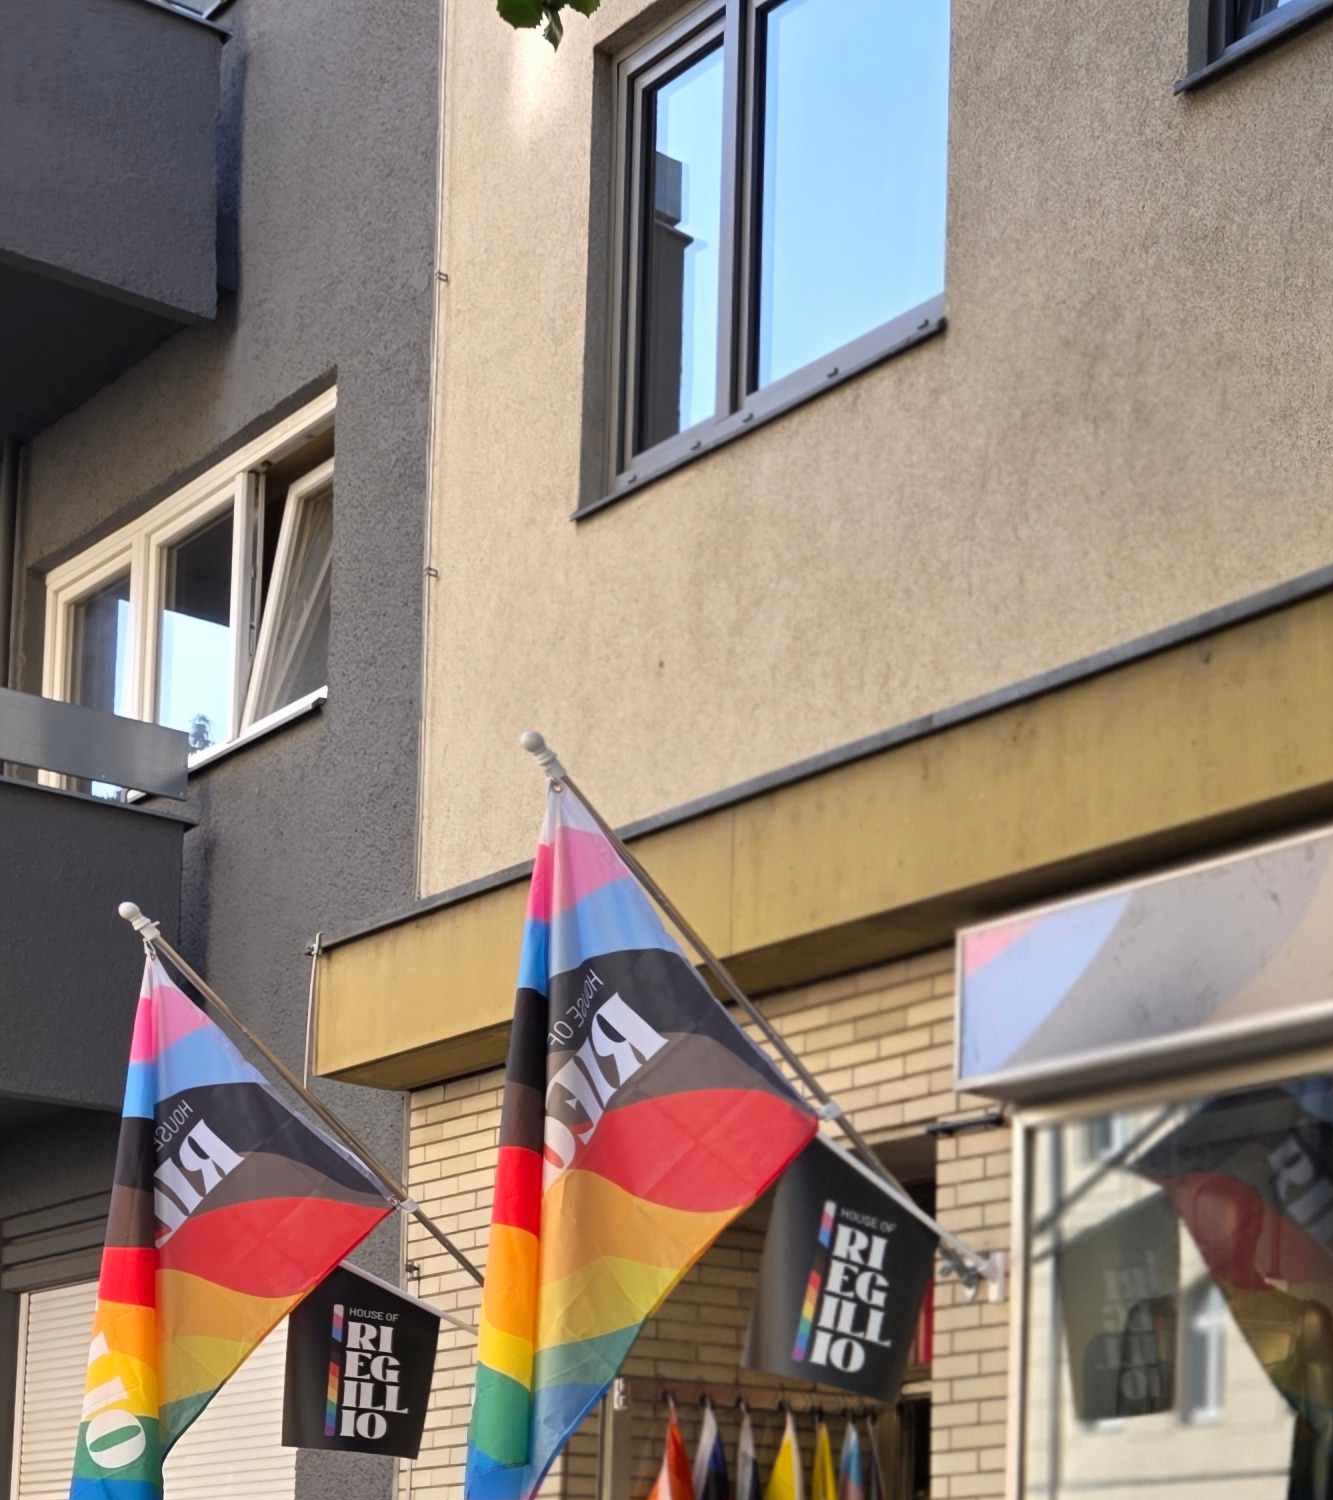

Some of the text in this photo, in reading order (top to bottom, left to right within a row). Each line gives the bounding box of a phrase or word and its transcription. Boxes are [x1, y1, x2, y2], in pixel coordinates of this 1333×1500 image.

[839, 1206, 897, 1234] HOUSE OF
[832, 1223, 888, 1269] RI
[824, 1264, 890, 1306] EG
[348, 1306, 399, 1322] HOUSE OF
[818, 1297, 892, 1347] ILL
[345, 1321, 393, 1353] RI
[809, 1328, 866, 1373] IO
[344, 1352, 400, 1383] EG
[343, 1380, 408, 1414] ILL
[339, 1409, 387, 1440] IO
